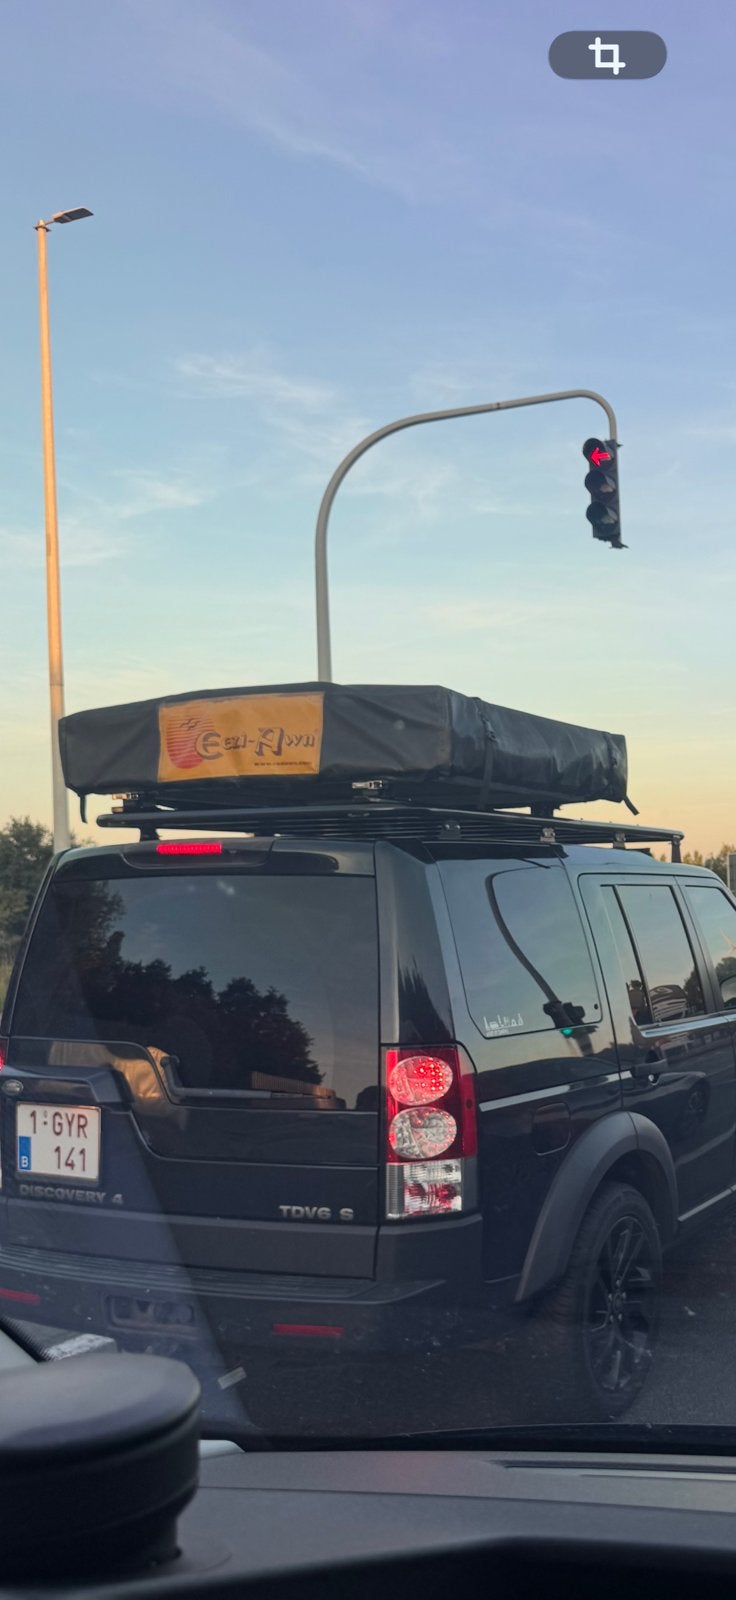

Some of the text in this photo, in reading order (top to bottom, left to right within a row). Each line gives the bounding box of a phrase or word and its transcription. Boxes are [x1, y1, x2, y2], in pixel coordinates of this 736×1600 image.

[21, 1155, 29, 1168] B
[54, 1145, 86, 1172] 141
[19, 1184, 124, 1205] DISCOVERY 4
[279, 1205, 354, 1221] TDV6 S
